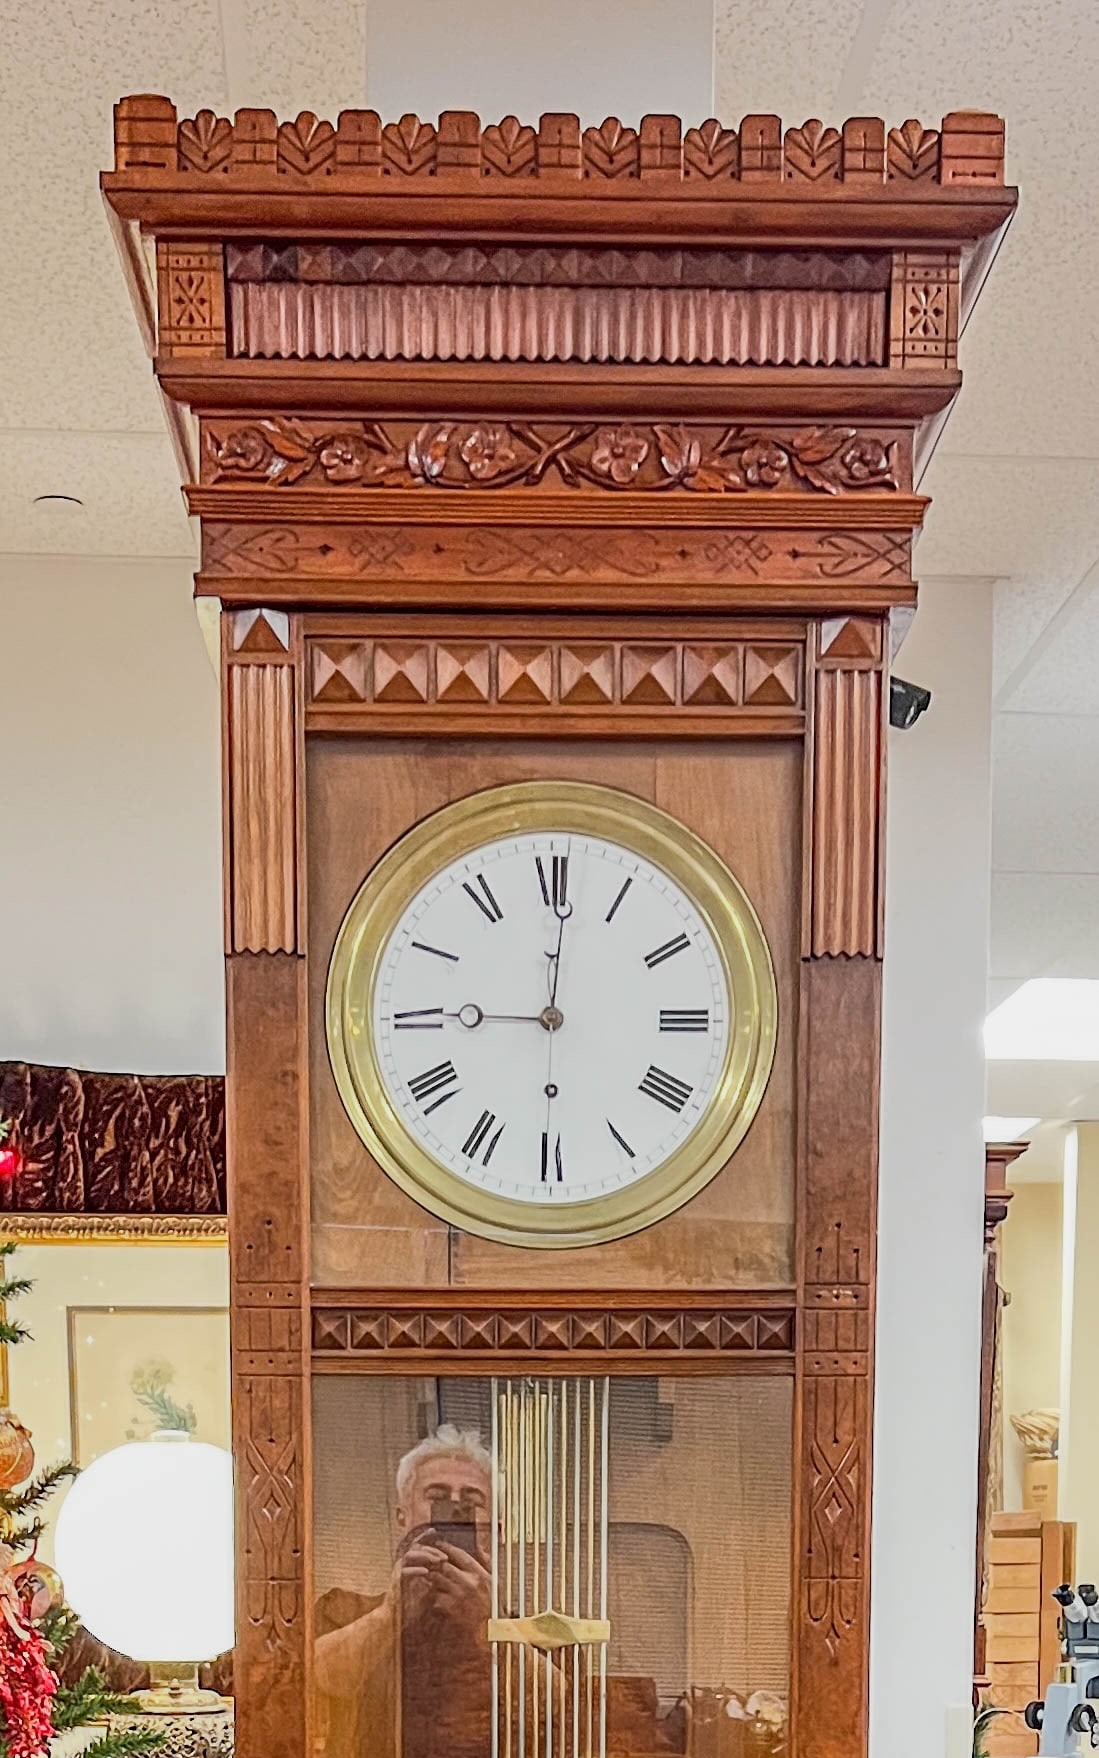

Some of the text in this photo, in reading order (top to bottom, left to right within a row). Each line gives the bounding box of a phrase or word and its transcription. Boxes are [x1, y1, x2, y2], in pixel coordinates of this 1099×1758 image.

[606, 877, 633, 922] I
[644, 932, 691, 969] II
[659, 1009, 709, 1032] III
[638, 1064, 693, 1113] IIII
